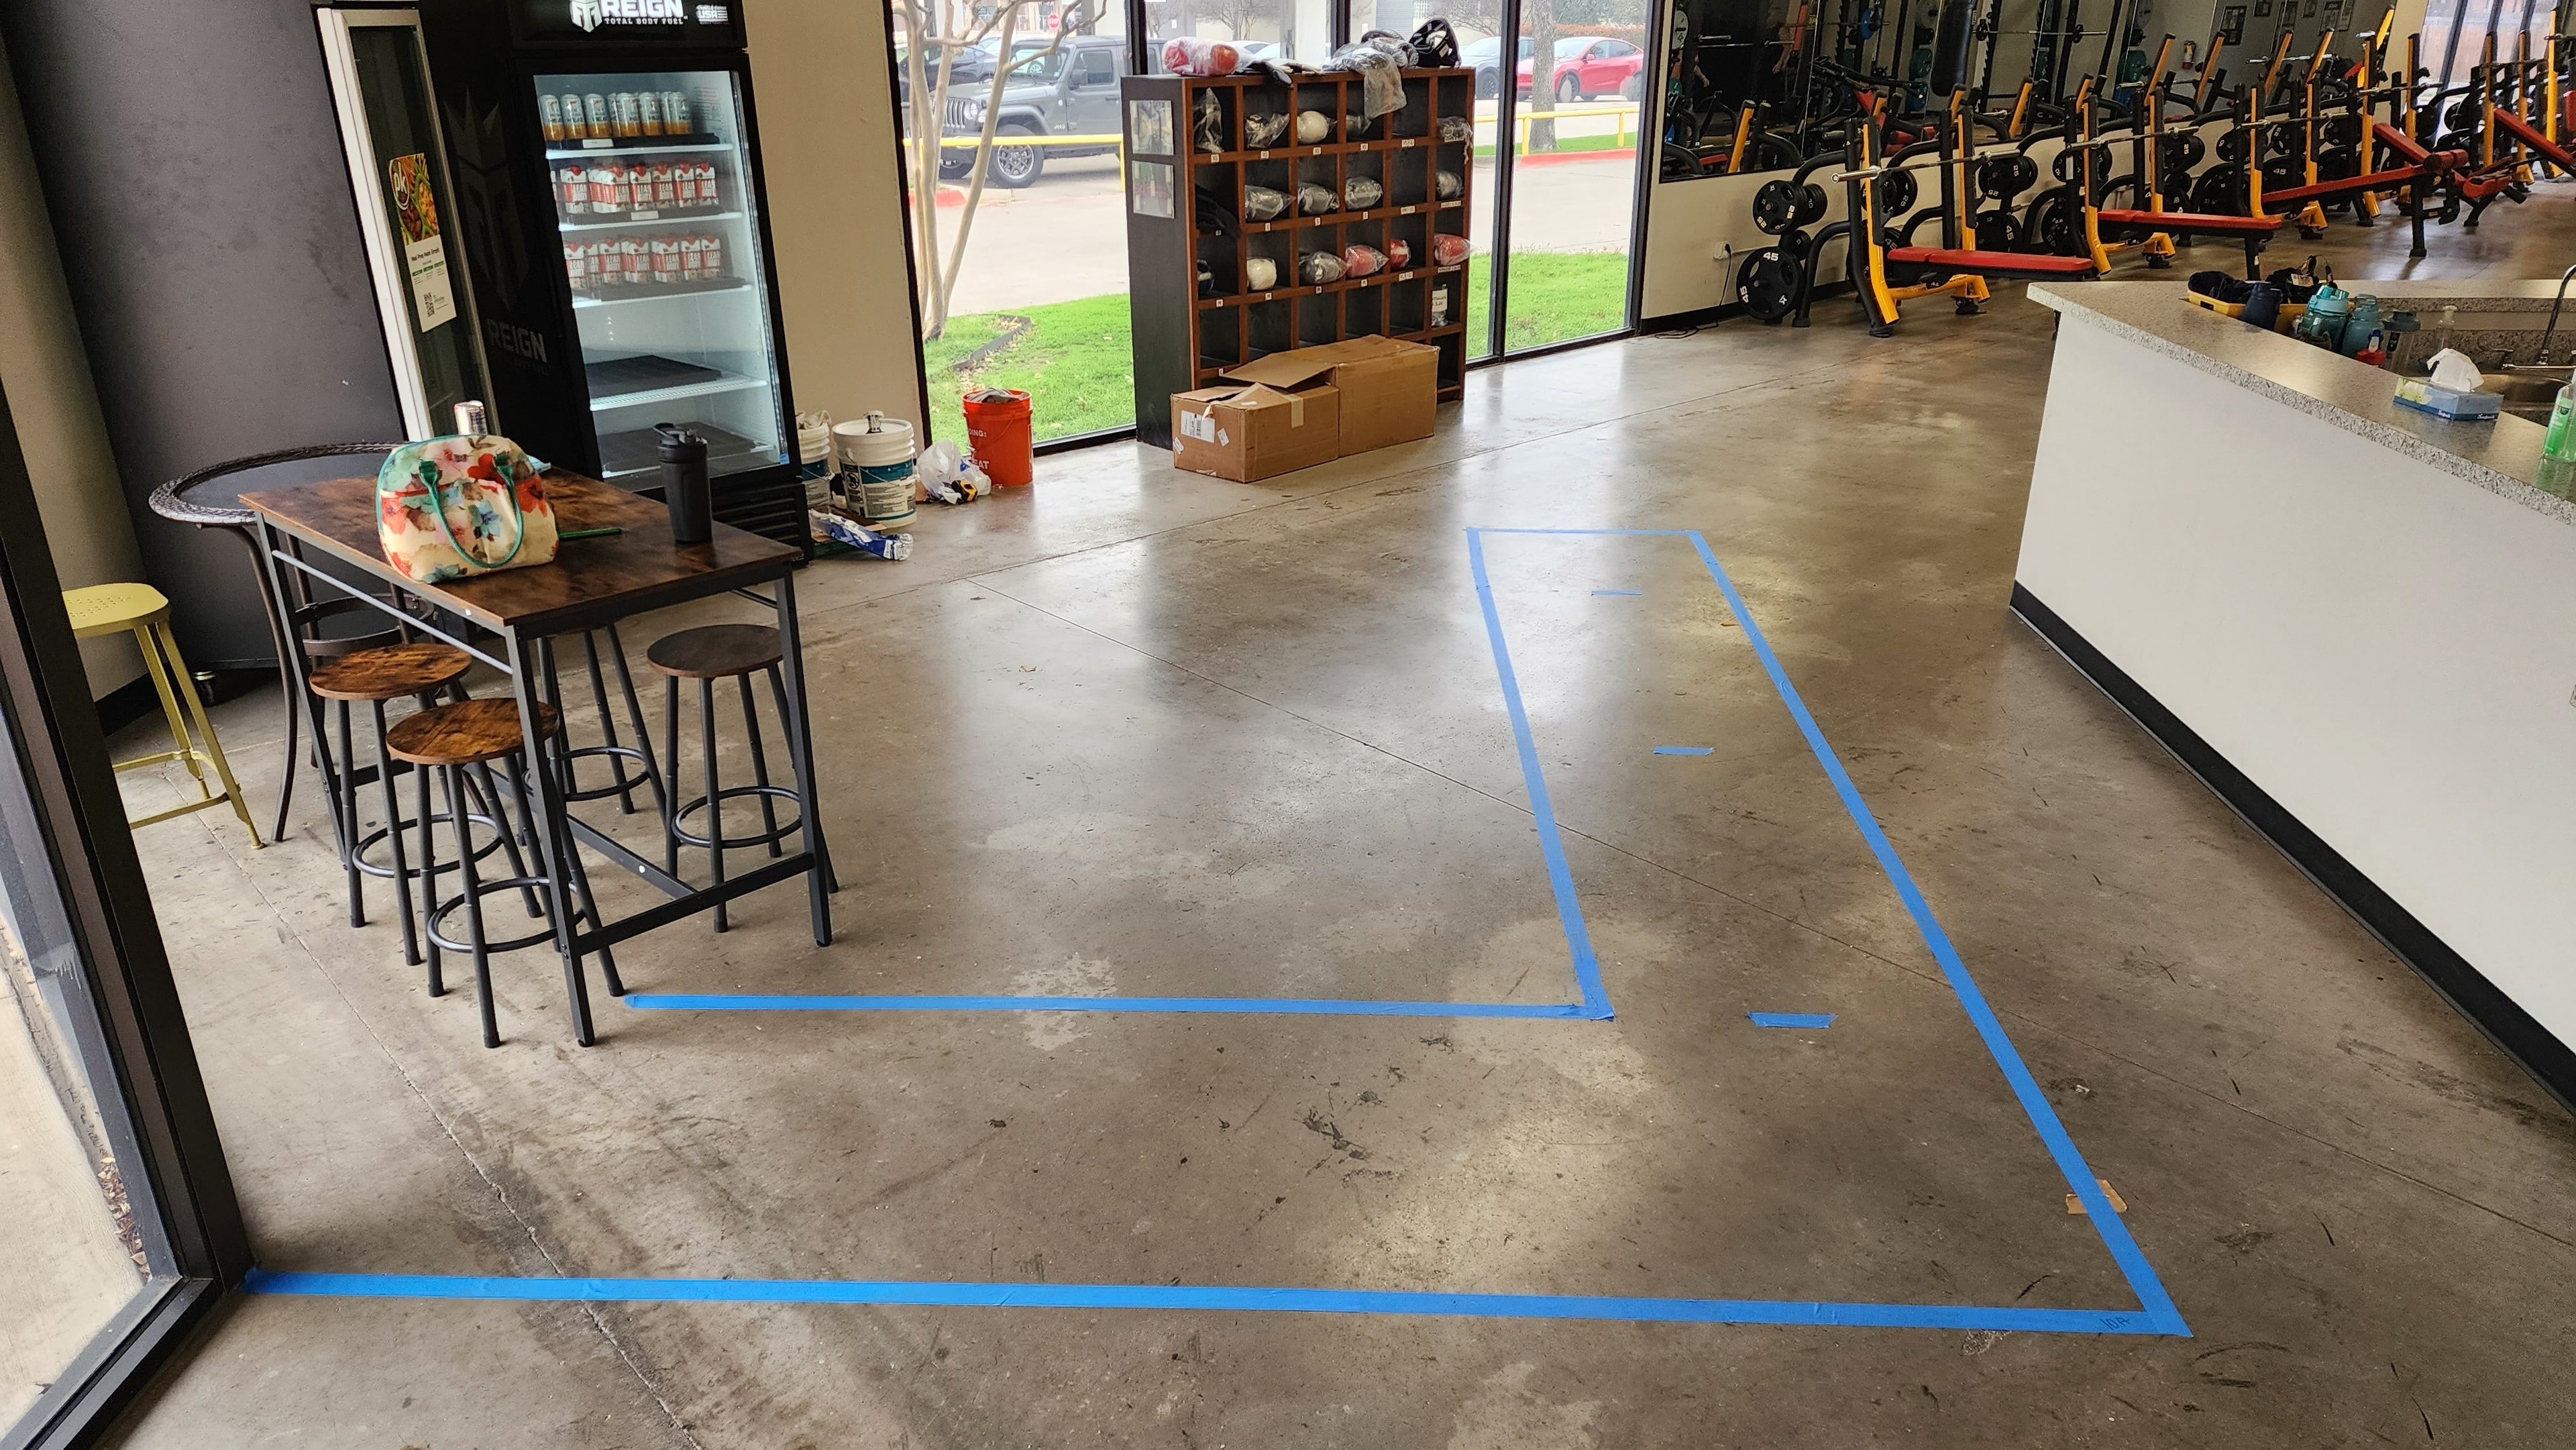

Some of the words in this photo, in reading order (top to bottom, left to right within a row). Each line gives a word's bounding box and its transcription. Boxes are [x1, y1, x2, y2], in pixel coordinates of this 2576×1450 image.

[602, 0, 684, 17] REIGN
[698, 10, 717, 18] USA
[2005, 225, 2015, 241] 45
[1763, 252, 1779, 262] 45
[1739, 286, 1750, 303] 45
[485, 317, 547, 363] REIGN
